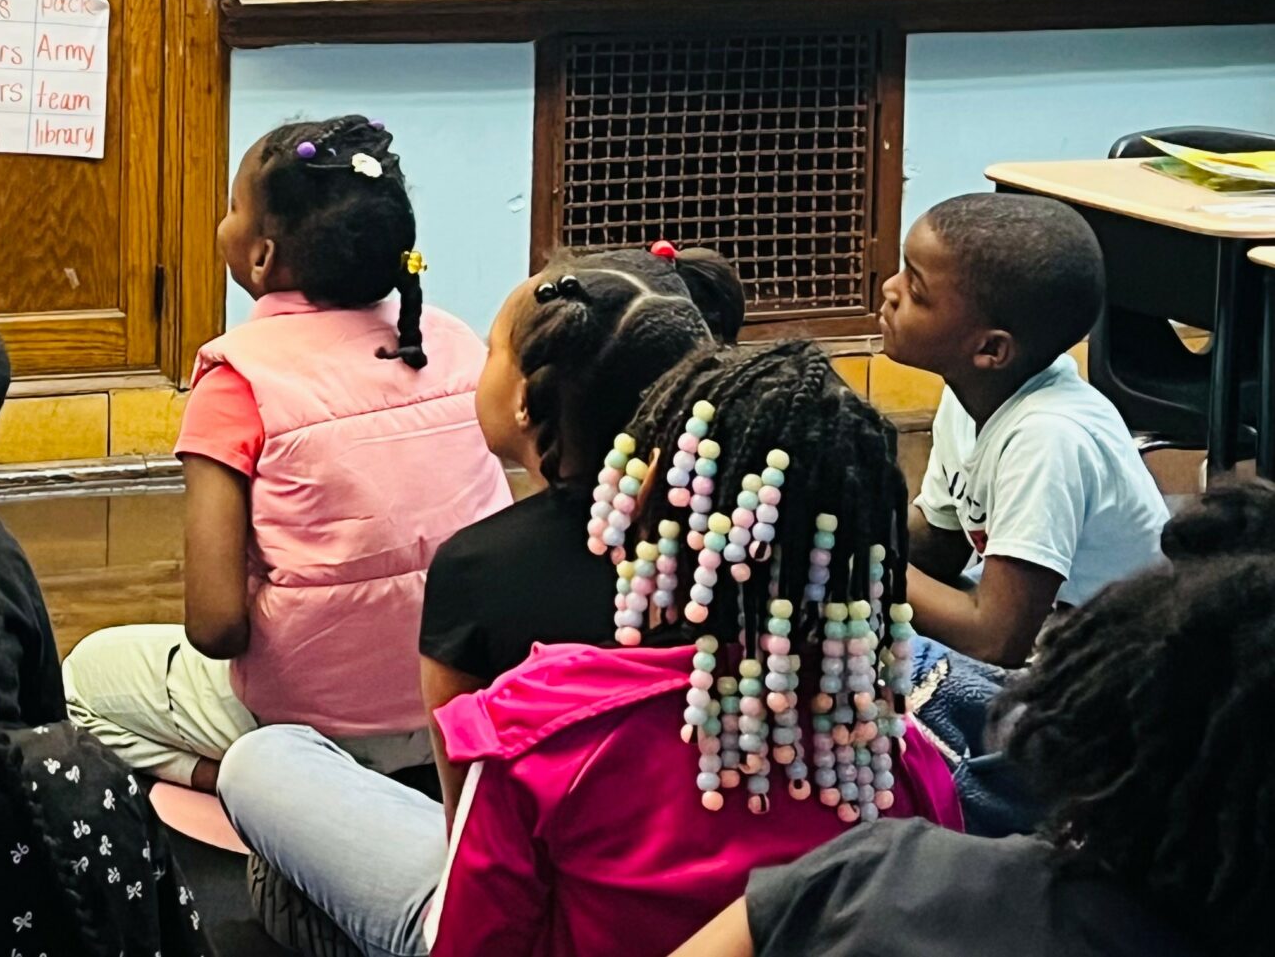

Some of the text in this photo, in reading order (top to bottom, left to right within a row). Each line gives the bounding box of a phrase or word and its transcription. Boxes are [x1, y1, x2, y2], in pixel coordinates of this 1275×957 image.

[37, 34, 95, 71] Army
[37, 80, 91, 111] team
[35, 119, 95, 153] library
